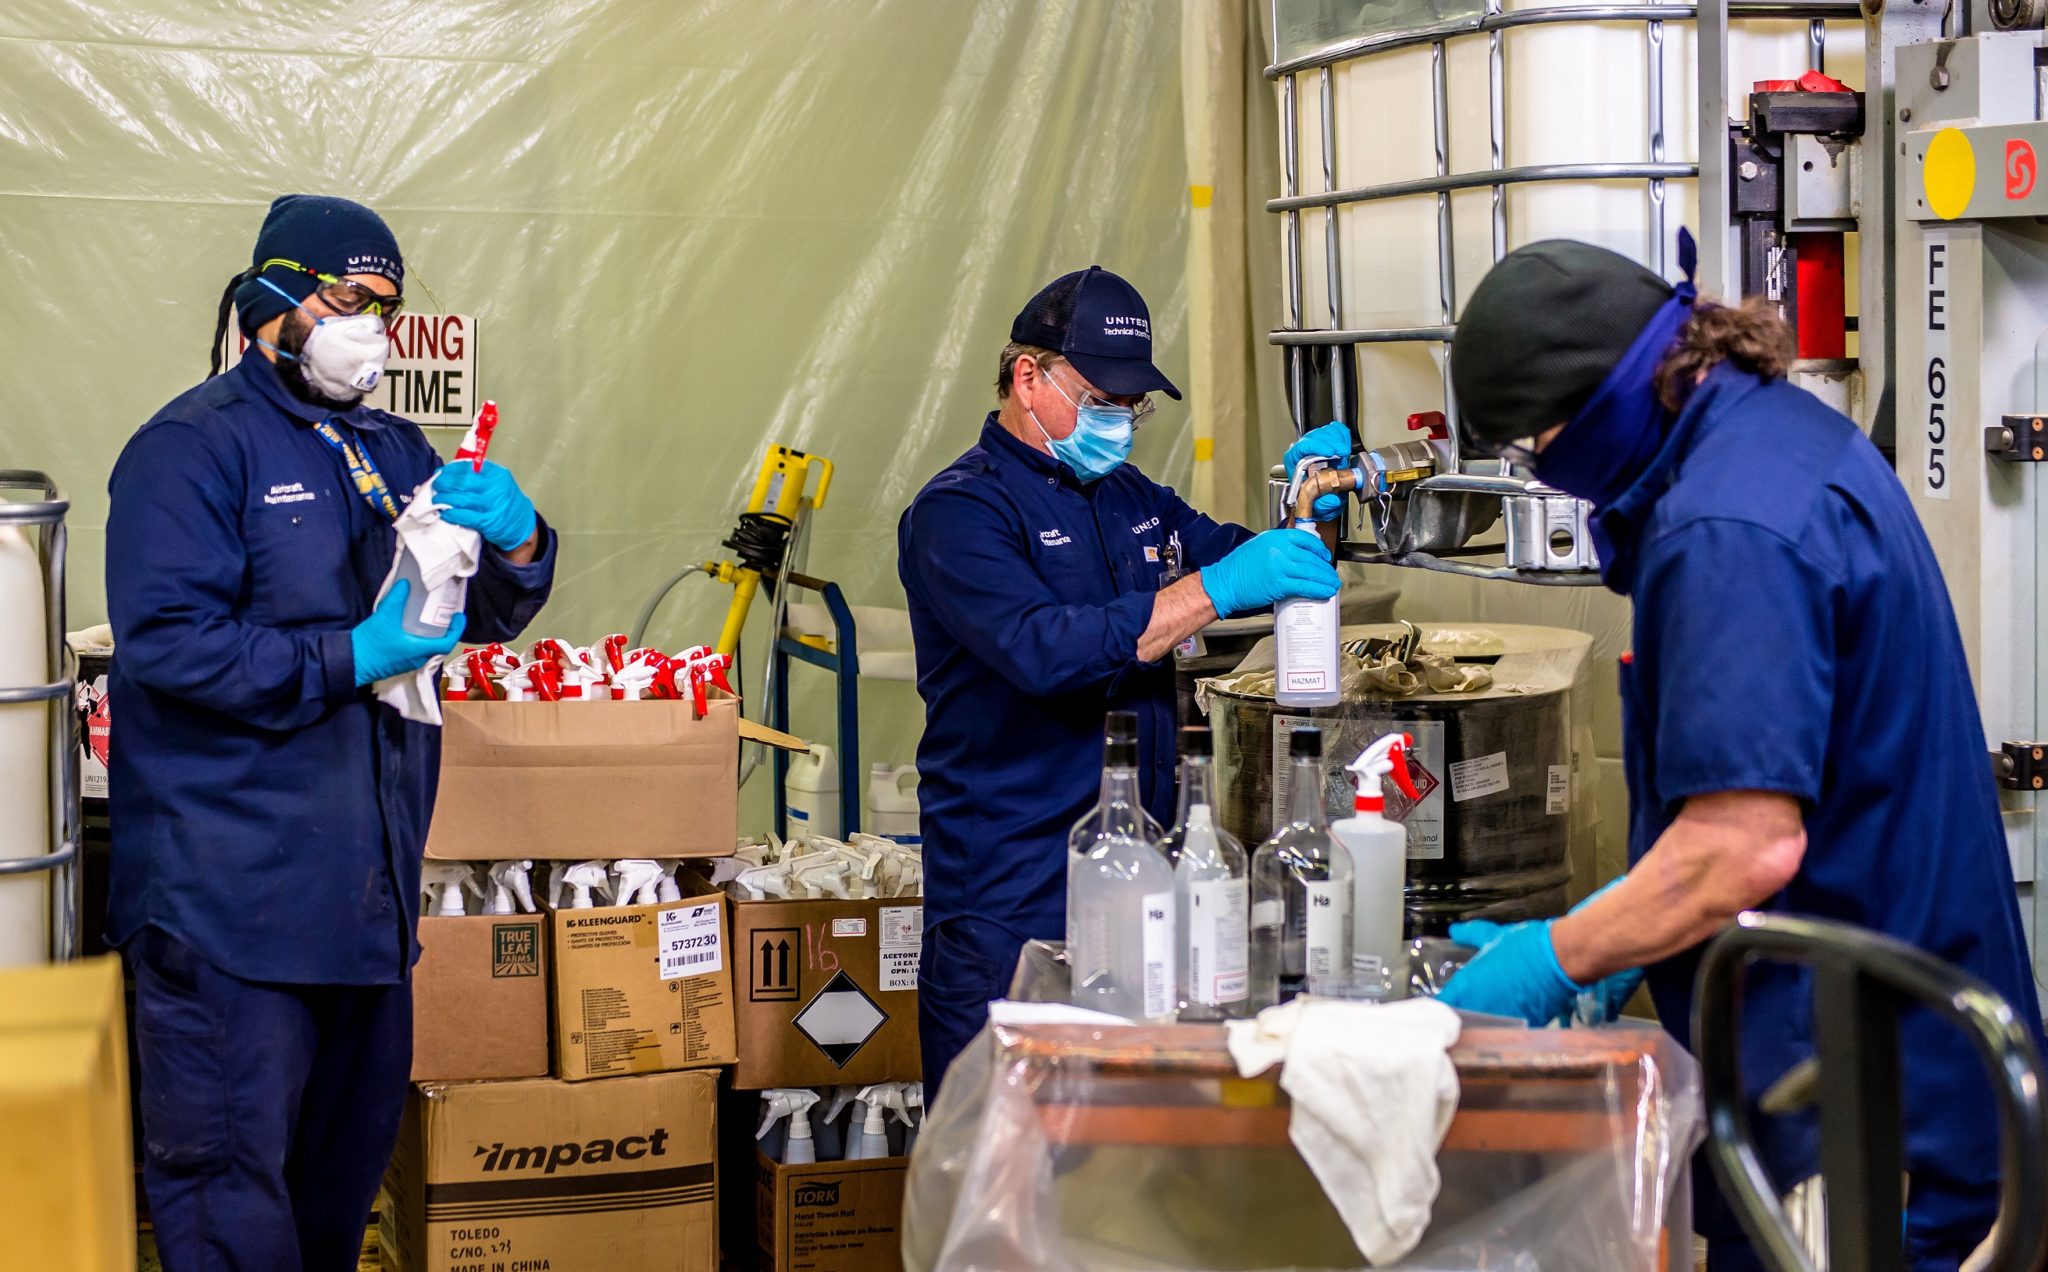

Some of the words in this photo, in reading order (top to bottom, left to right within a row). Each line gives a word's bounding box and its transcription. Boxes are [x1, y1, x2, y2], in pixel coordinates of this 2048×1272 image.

[1928, 244, 1946, 331] FE
[1103, 327, 1134, 336] Technical
[383, 369, 463, 414] TIME
[1927, 357, 1946, 490] 655
[1291, 677, 1321, 685] HAZMAT
[500, 930, 531, 943] TRUE
[570, 930, 599, 938] PROTECTIVE
[599, 929, 618, 937] GLOVES
[598, 934, 625, 942] PROTECTION
[502, 942, 531, 955] LEAF
[671, 933, 718, 951] 5737230
[806, 922, 840, 972] 16
[500, 954, 532, 964] FARMS
[883, 952, 918, 960] ACETONE
[889, 979, 909, 988] BOX:
[473, 1127, 669, 1174] impact
[796, 1189, 836, 1204] TORK
[794, 1212, 814, 1220] Hand
[816, 1210, 839, 1219] Towel
[840, 1208, 856, 1217] Roll
[450, 1227, 500, 1241] TOLEDO
[450, 1245, 487, 1259] C/NO.
[491, 1262, 505, 1272] IN
[511, 1259, 551, 1272] CHINA
